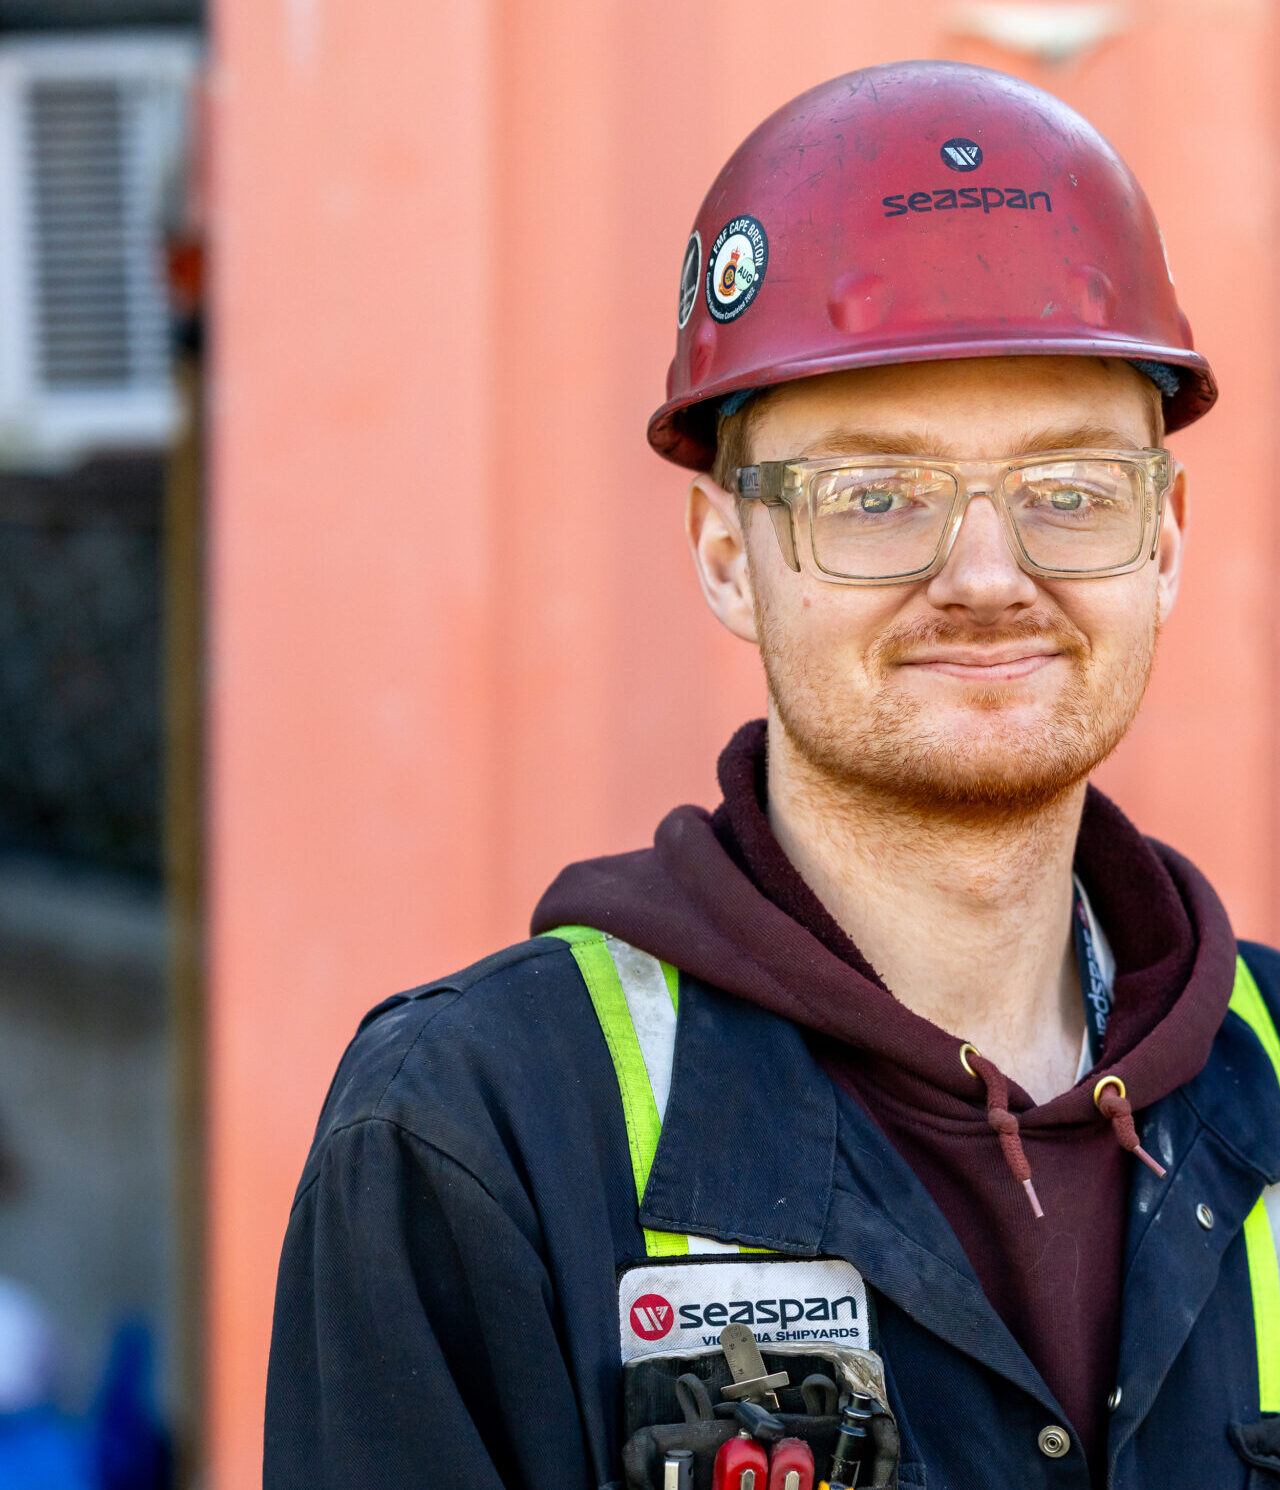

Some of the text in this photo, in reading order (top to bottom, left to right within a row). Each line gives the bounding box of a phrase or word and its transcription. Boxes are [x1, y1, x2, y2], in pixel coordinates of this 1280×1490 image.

[882, 187, 1052, 217] seaspan
[713, 219, 764, 267] FMF CAPE BRETON
[737, 266, 753, 284] AUG
[678, 1295, 858, 1330] seaspan
[776, 1327, 859, 1342] SHIPYARDS
